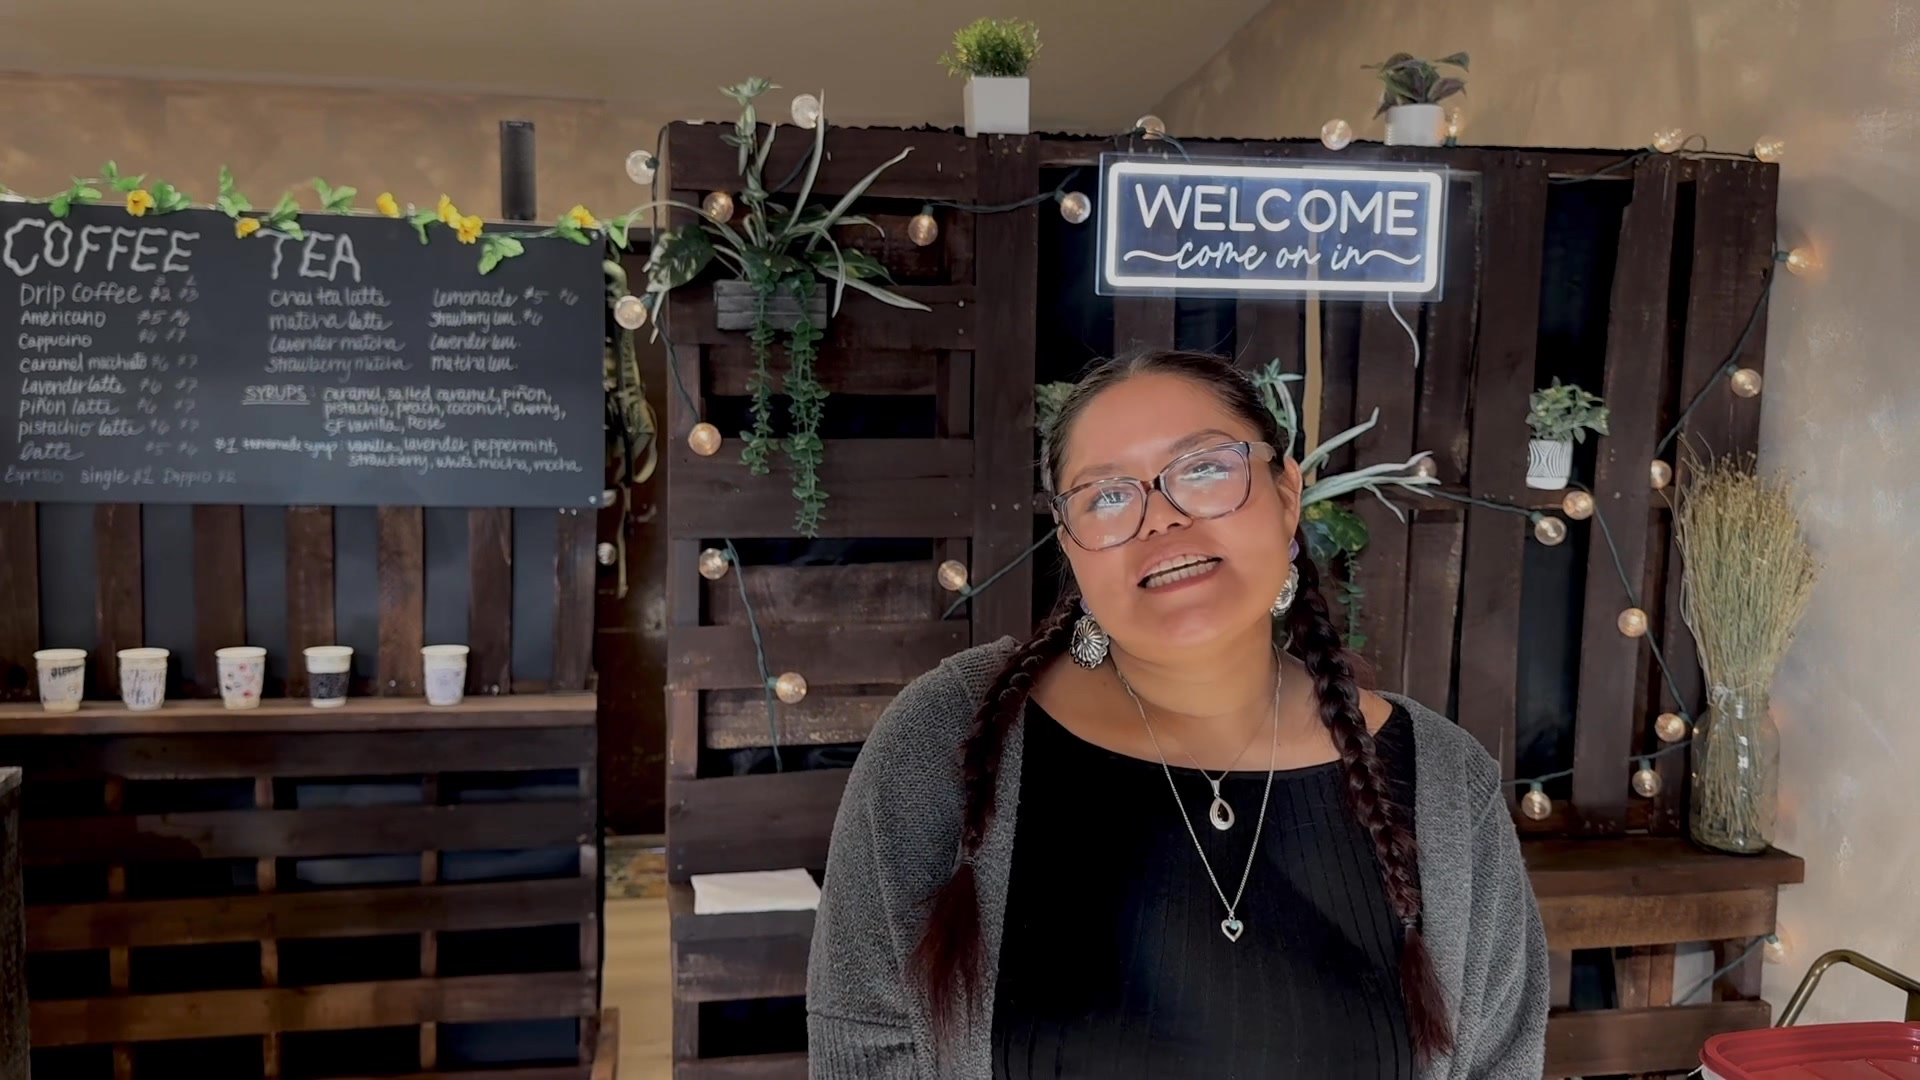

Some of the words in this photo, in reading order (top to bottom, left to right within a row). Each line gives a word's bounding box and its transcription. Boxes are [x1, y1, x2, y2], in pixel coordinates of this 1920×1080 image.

[1135, 183, 1419, 236] WELCOME
[3, 218, 200, 276] COFFEE
[256, 228, 362, 282] TEA
[1177, 241, 1267, 271] come
[1276, 244, 1321, 269] on
[20, 281, 65, 310] Drip
[72, 282, 143, 304] Coffee
[344, 285, 392, 307] latte
[20, 310, 107, 328] Americano
[348, 309, 394, 330] latte
[140, 377, 162, 395] $6
[175, 377, 199, 393] $7
[19, 396, 66, 419] piñon
[72, 397, 120, 415] latte
[174, 398, 196, 413] $7
[98, 417, 145, 436] latte
[80, 465, 130, 491] single
